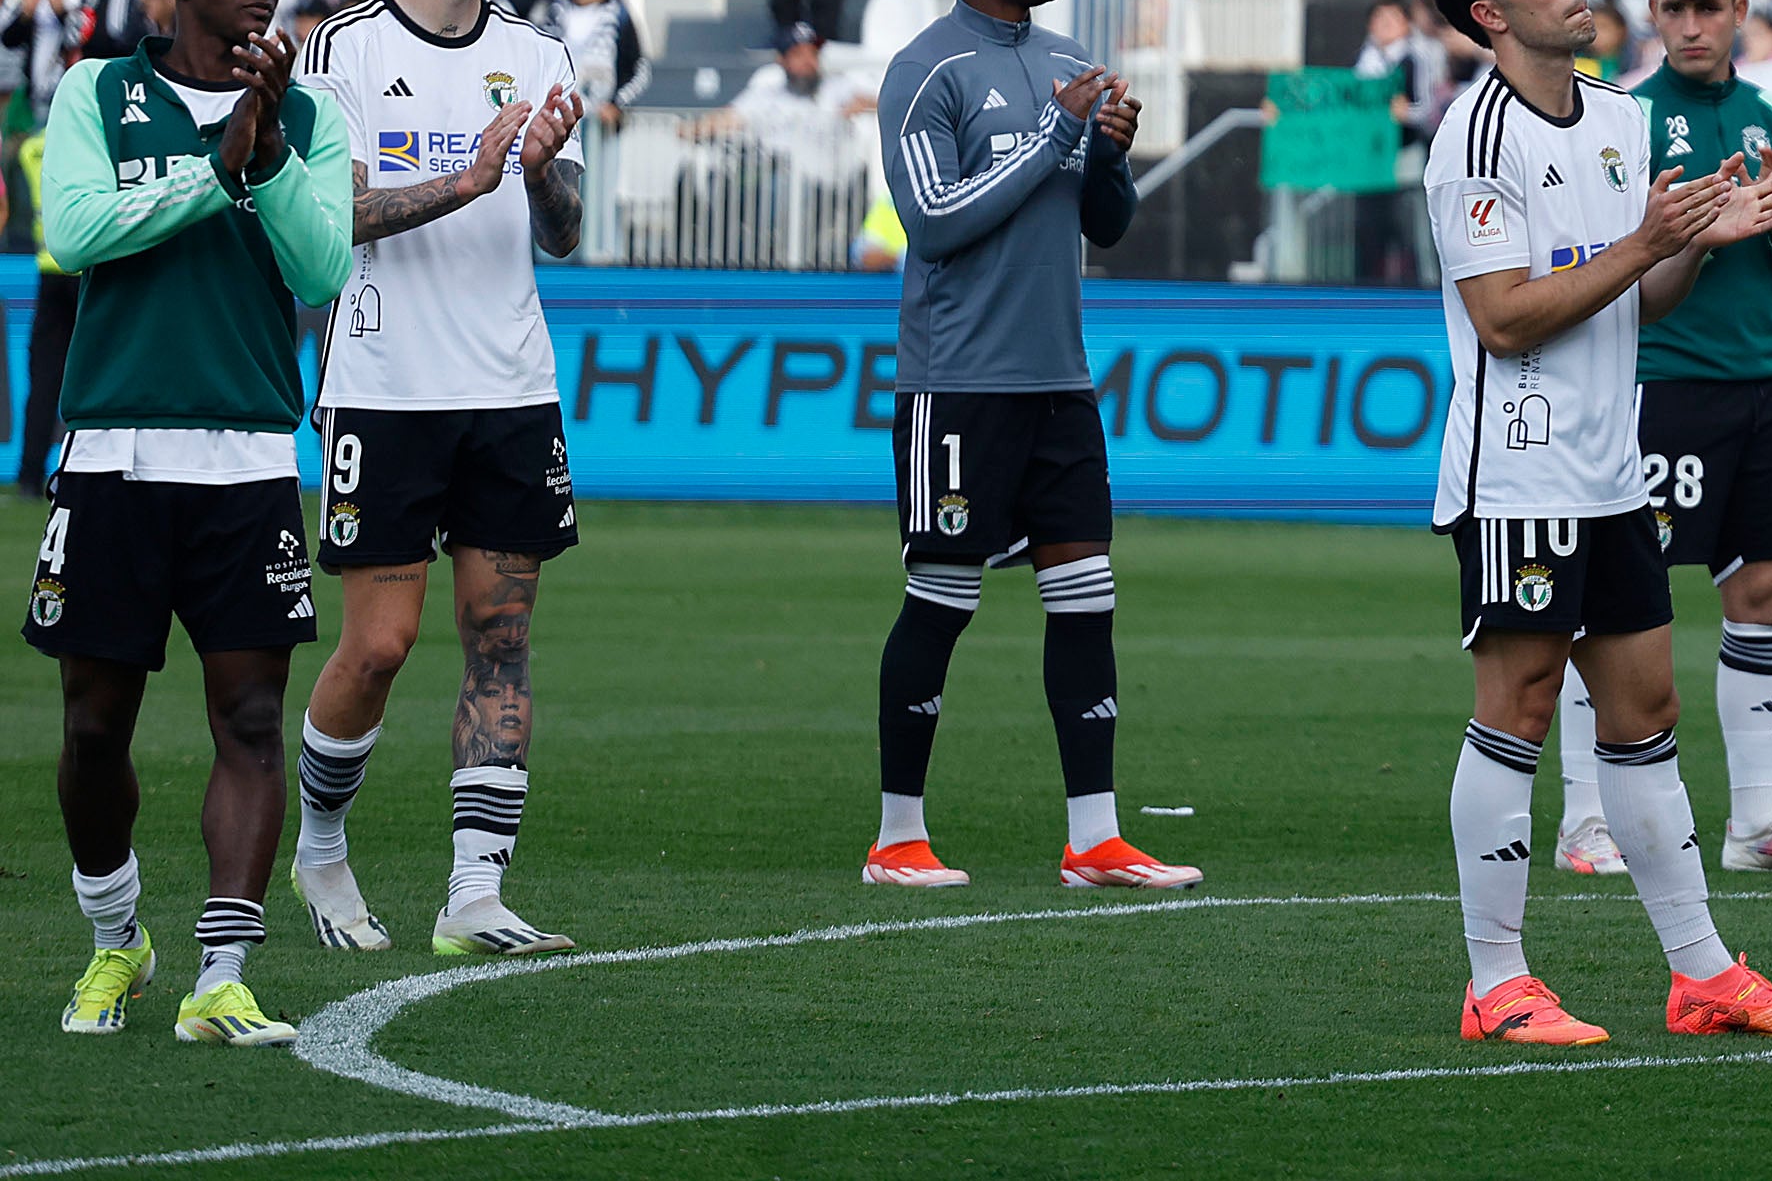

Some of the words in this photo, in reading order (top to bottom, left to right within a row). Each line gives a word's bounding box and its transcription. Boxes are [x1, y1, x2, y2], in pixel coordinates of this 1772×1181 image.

[122, 80, 147, 104] 14
[1666, 115, 1690, 139] 28
[428, 132, 522, 155] REAE
[1472, 227, 1502, 239] LALIGA
[1518, 351, 1530, 389] Burgo
[333, 433, 363, 495] 9
[941, 434, 961, 490] 1
[1641, 454, 1704, 509] 28
[280, 580, 308, 592] Burgos
